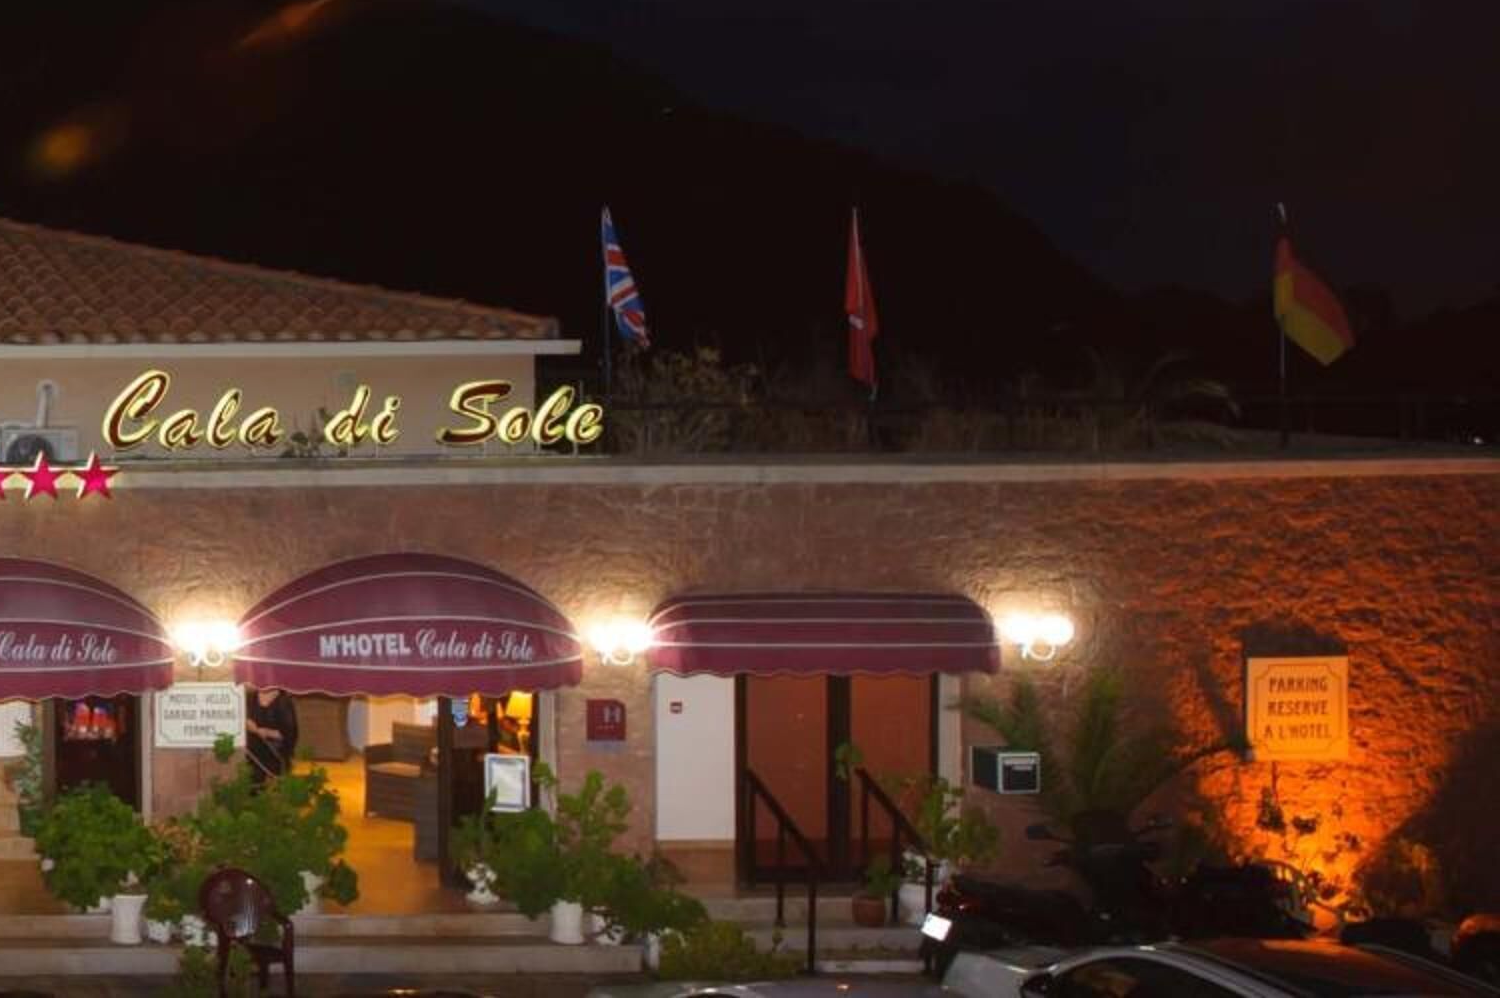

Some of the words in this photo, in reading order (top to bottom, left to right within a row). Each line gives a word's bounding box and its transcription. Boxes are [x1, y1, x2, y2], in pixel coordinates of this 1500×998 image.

[101, 369, 283, 450] Cala
[323, 384, 401, 447] di
[436, 379, 603, 446] Sole
[50, 633, 73, 660] di
[319, 633, 411, 658] M'HOTEL
[415, 628, 469, 659] Cala
[472, 631, 493, 659] di
[1268, 675, 1329, 693] PARKING
[1267, 699, 1329, 716] RESERVE
